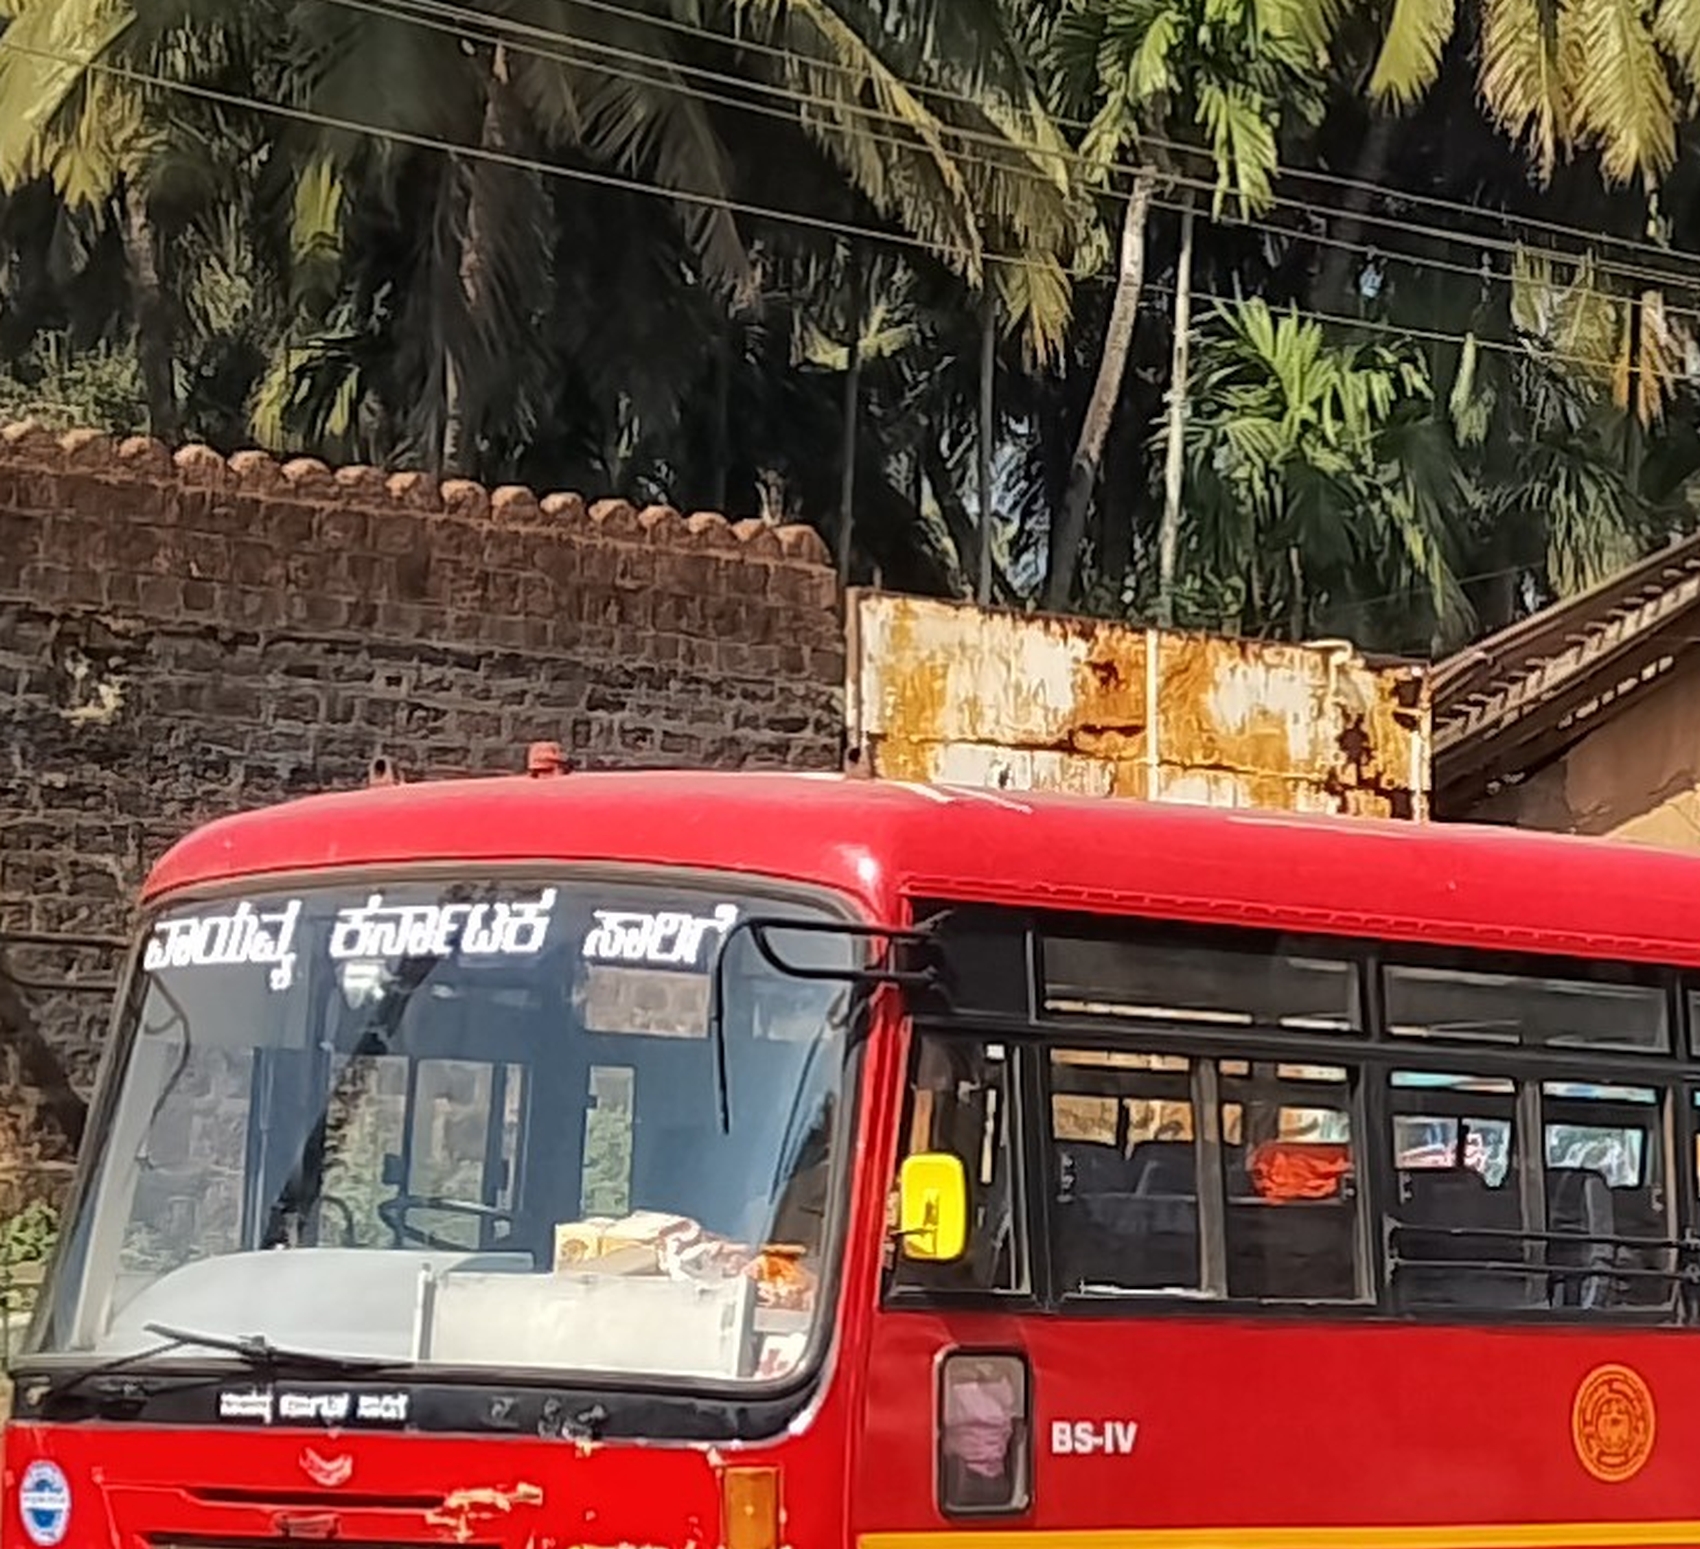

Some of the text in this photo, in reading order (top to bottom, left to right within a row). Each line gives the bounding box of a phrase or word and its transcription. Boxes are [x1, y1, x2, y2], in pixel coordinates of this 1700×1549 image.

[144, 887, 739, 991] ವಾಯವ್ಯ ಕರ್ನಾಟಕ ಸಾರಿಗೆ
[1051, 1420, 1138, 1455] BS-IV
